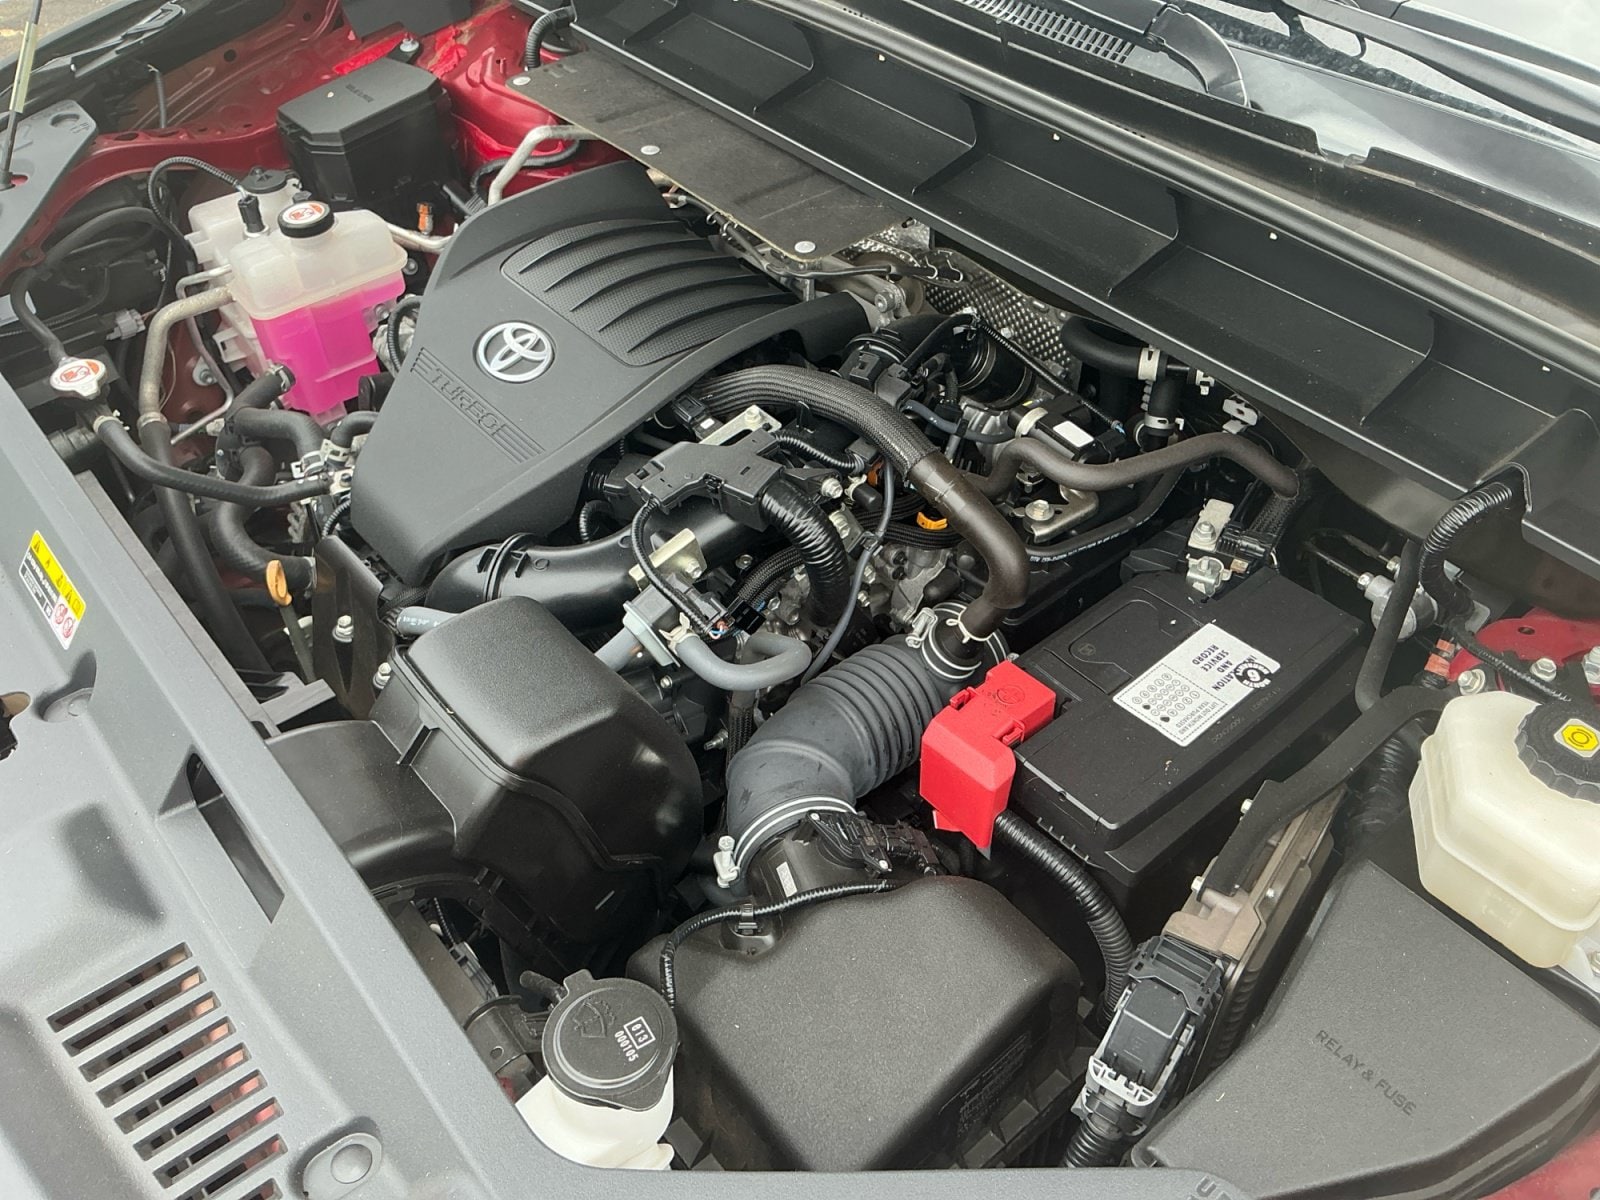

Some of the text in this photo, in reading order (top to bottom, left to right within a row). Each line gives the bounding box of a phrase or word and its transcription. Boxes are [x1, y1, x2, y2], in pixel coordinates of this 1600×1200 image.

[431, 366, 500, 429] TURBO
[1192, 644, 1219, 665] RECORD
[1200, 650, 1229, 672] SERVICE
[1216, 660, 1233, 673] AND
[614, 1030, 639, 1062] 000105
[1316, 1030, 1417, 1116] RELAY & FUSE
